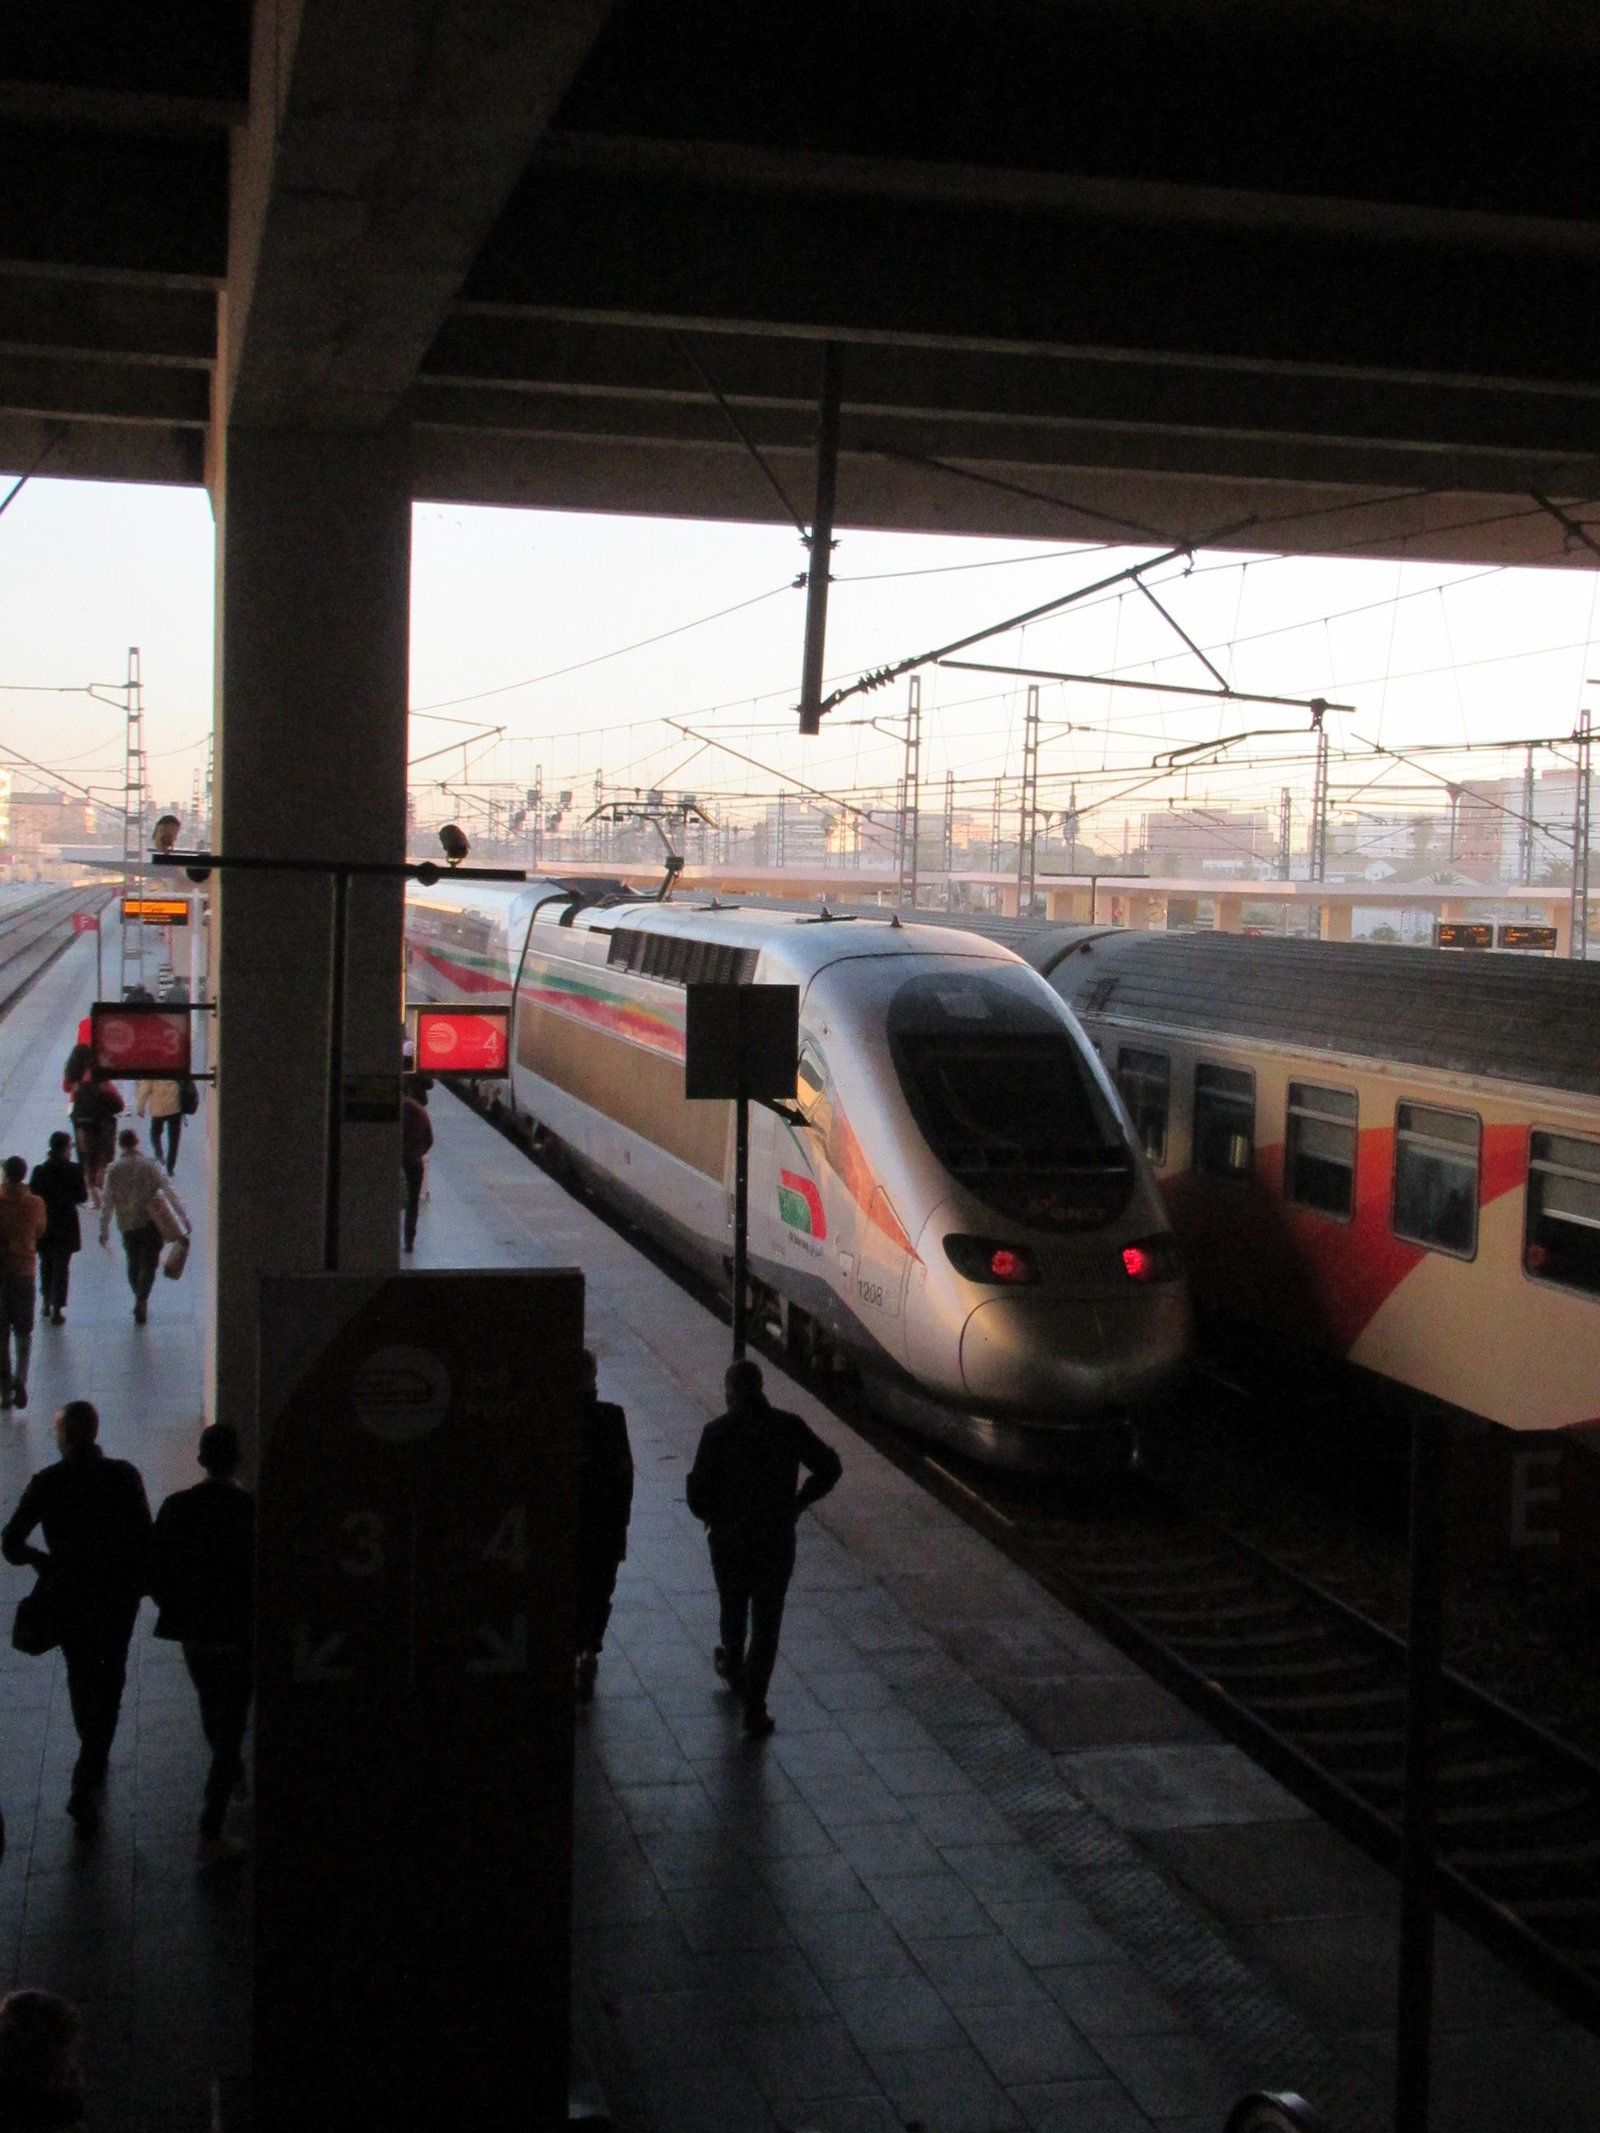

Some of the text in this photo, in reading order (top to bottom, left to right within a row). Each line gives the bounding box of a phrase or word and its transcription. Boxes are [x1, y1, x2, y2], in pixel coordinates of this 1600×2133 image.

[163, 1030, 180, 1055] 3
[482, 1030, 499, 1054] 4
[857, 1279, 884, 1306] 1208
[1510, 1450, 1563, 1546] E
[339, 1509, 386, 1577] 3
[481, 1503, 531, 1572] 4
